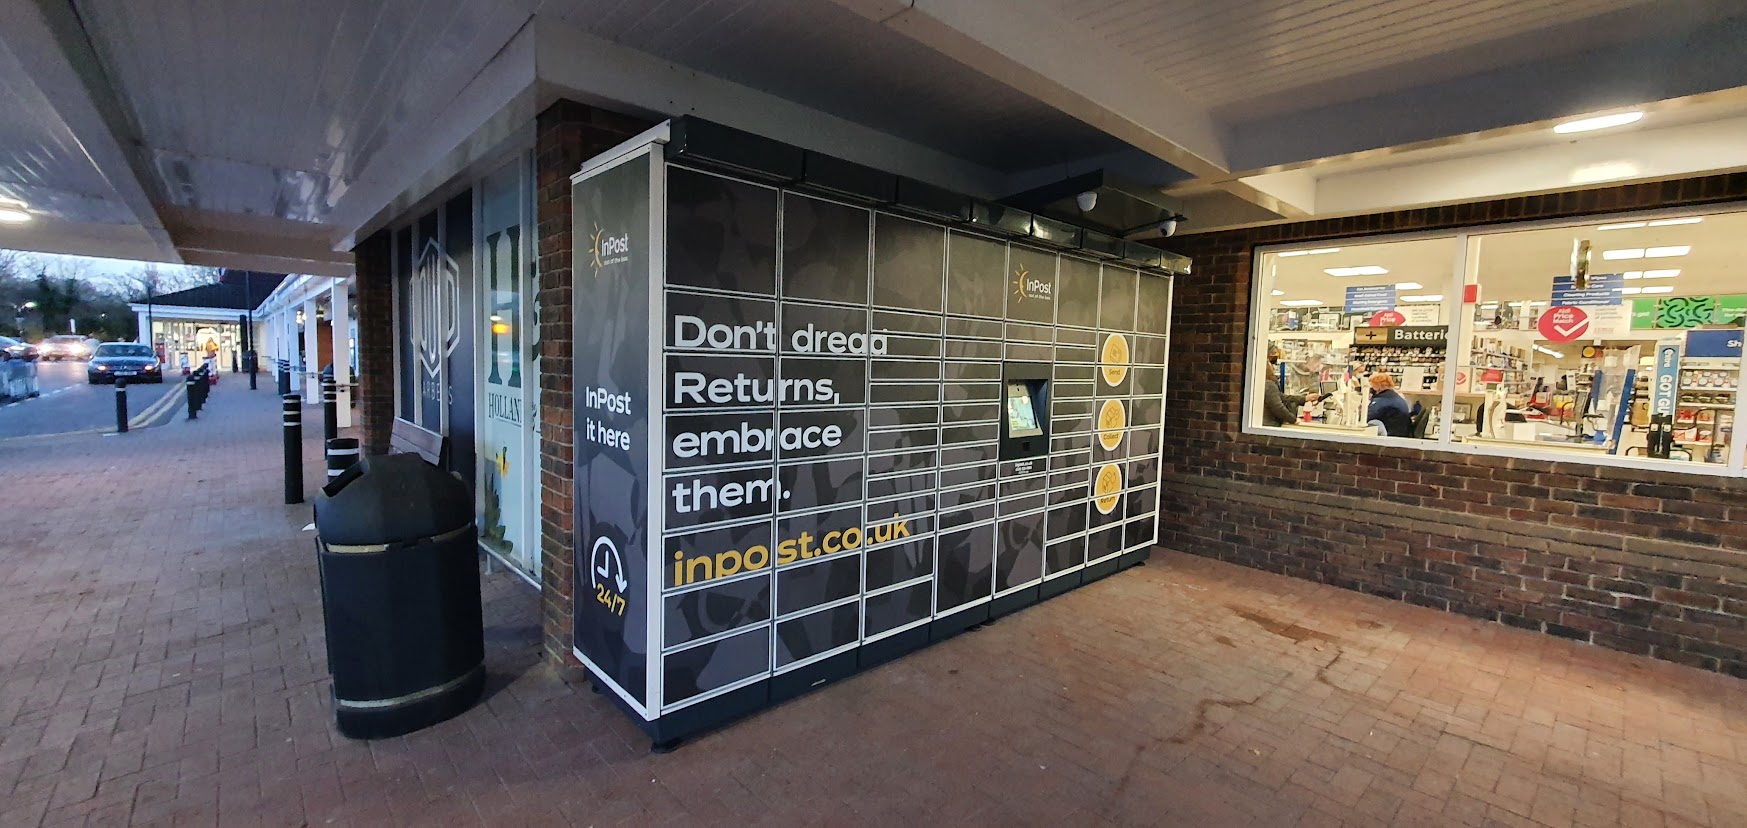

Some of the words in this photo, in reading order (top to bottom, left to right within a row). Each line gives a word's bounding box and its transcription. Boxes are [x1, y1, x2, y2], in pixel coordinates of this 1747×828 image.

[601, 233, 628, 257] InPost
[1027, 278, 1051, 294] InPost
[674, 315, 777, 350] Don't
[585, 386, 632, 415] InPost
[674, 372, 840, 405] Returns,
[586, 417, 596, 440] it
[596, 423, 631, 451] here
[672, 422, 842, 458] embrace
[671, 478, 791, 514] them.
[673, 513, 911, 587] inpost.co.uk
[597, 583, 626, 616] 24/7
